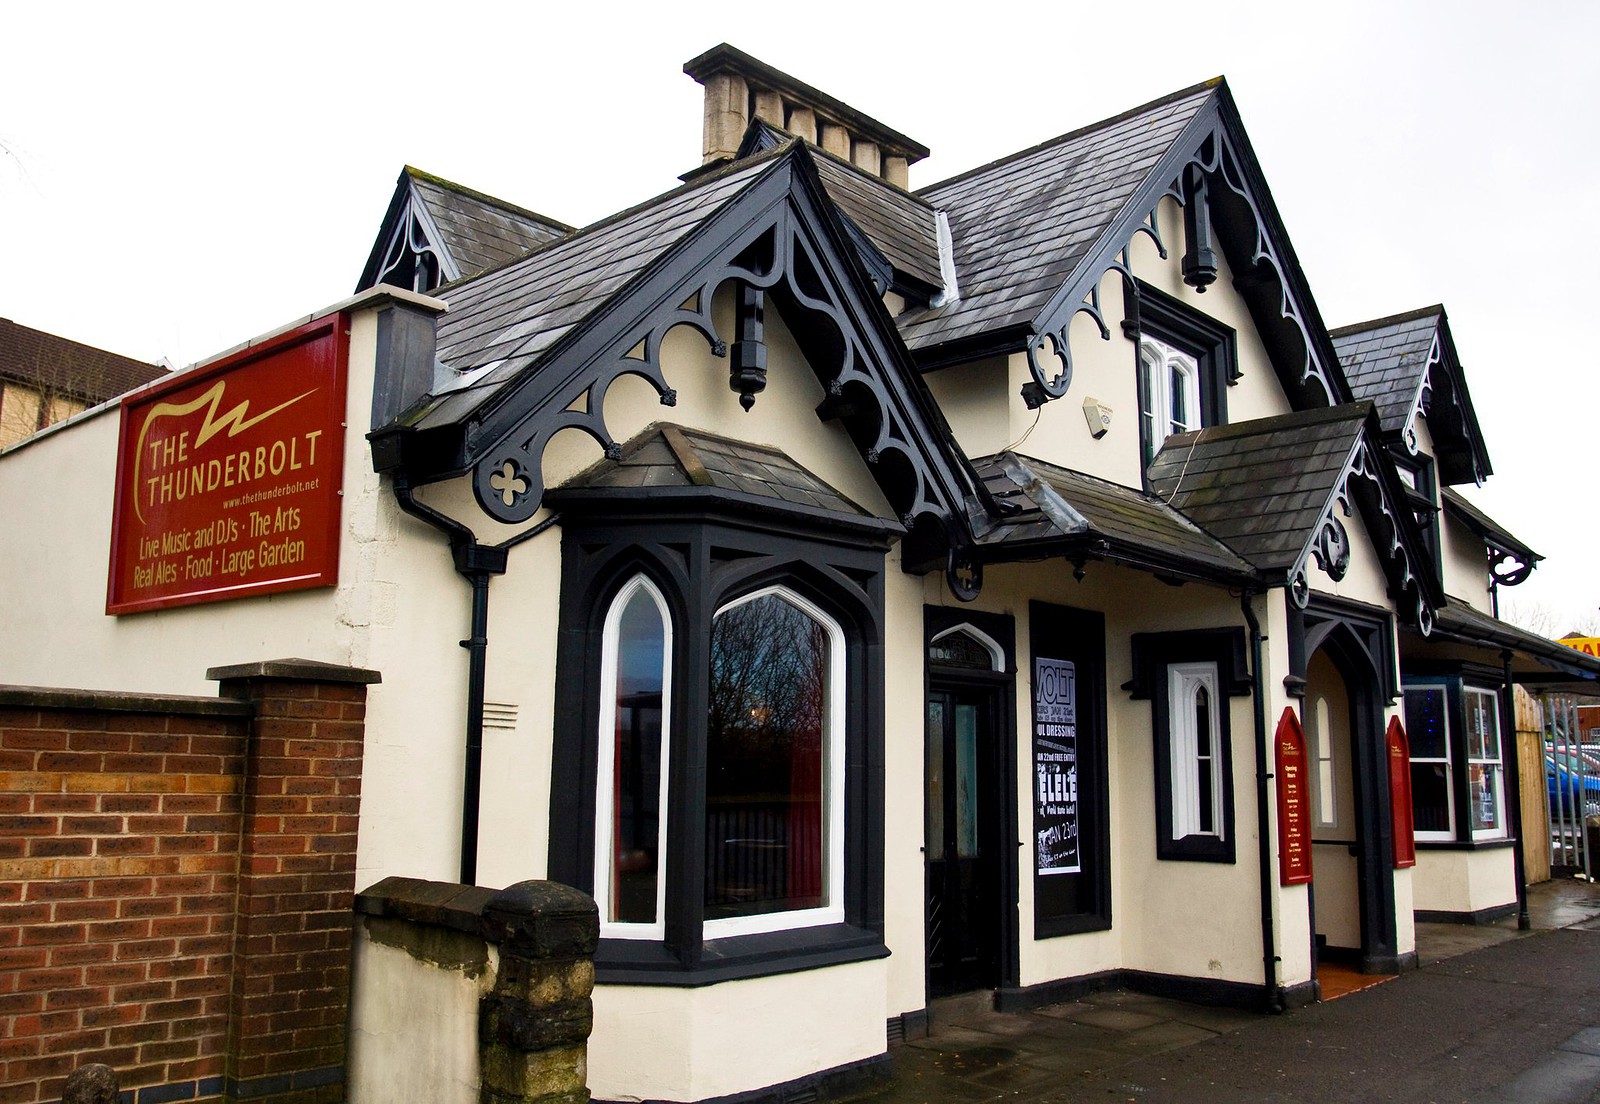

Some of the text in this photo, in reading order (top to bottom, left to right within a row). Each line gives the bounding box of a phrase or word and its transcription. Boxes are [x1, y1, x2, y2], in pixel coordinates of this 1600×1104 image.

[150, 431, 189, 470] THE
[147, 430, 322, 507] THUNDERBOLT
[223, 478, 319, 509] www.thethunderbolt.net
[140, 506, 300, 560] Live Music and DJ's The Arts
[134, 536, 305, 589] Real Ales Food Large Garden
[1046, 724, 1075, 738] DRESSING
[1055, 753, 1063, 761] FREE
[1064, 753, 1075, 762] ENTRY
[1062, 819, 1077, 840] 23rd
